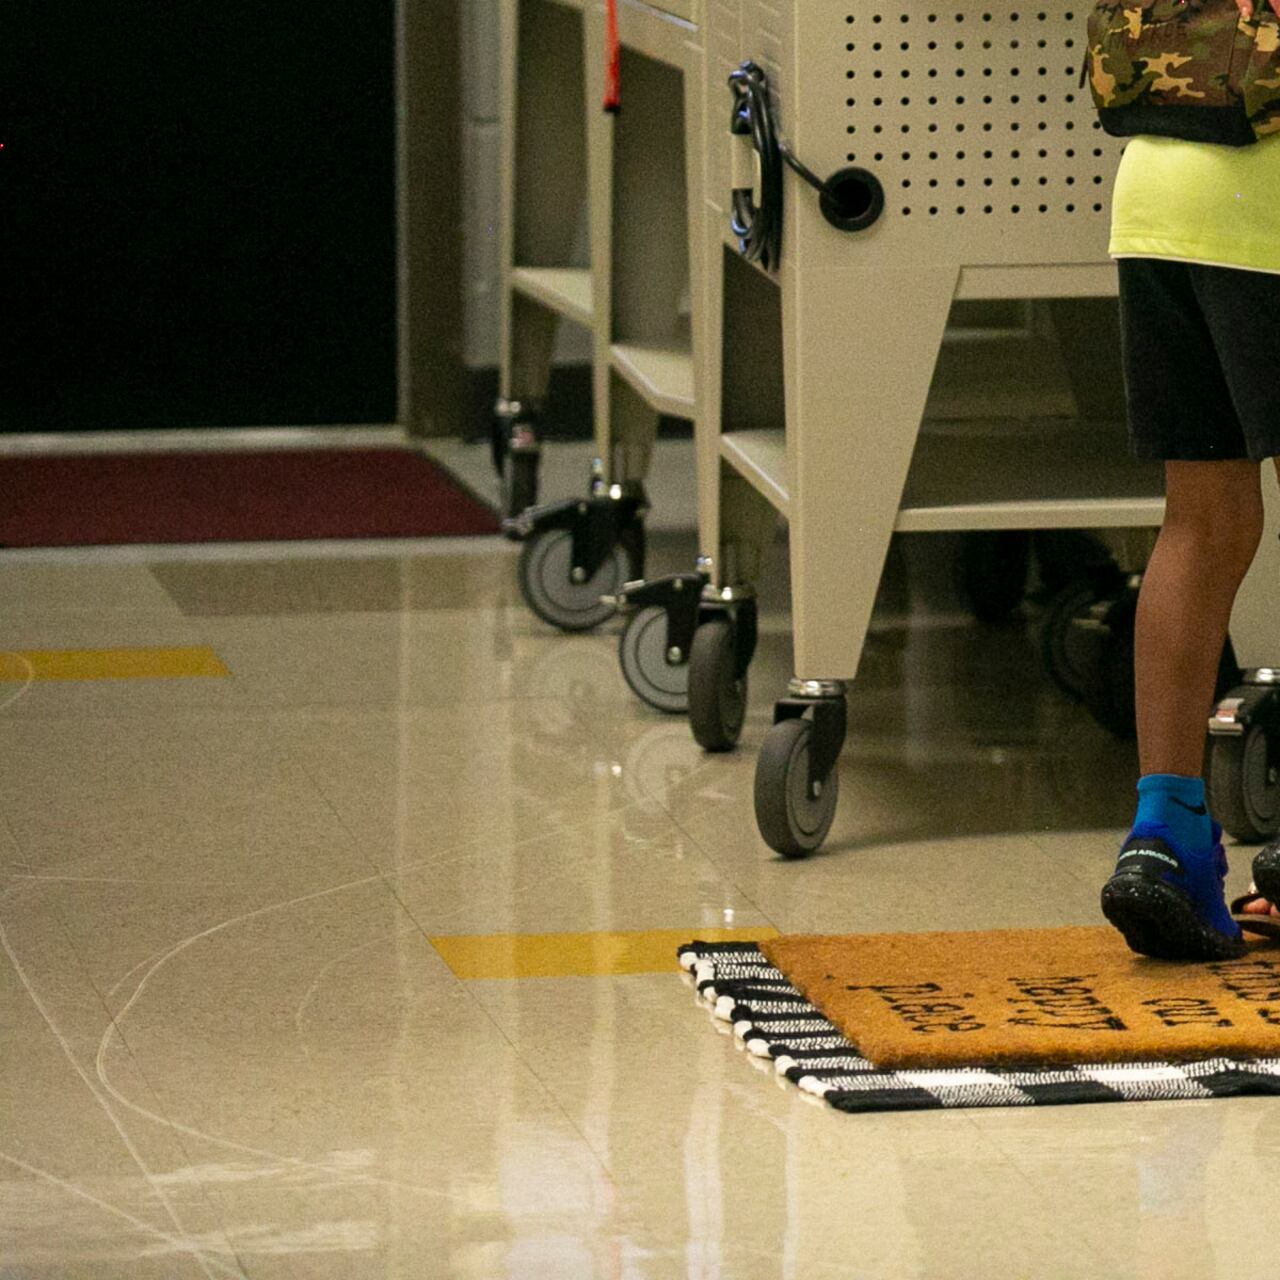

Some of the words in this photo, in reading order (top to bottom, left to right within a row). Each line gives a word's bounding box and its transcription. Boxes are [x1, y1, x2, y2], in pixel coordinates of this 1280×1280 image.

[846, 981, 986, 1033] place
[1006, 973, 1128, 1032] happy
[1140, 996, 1234, 1027] our
